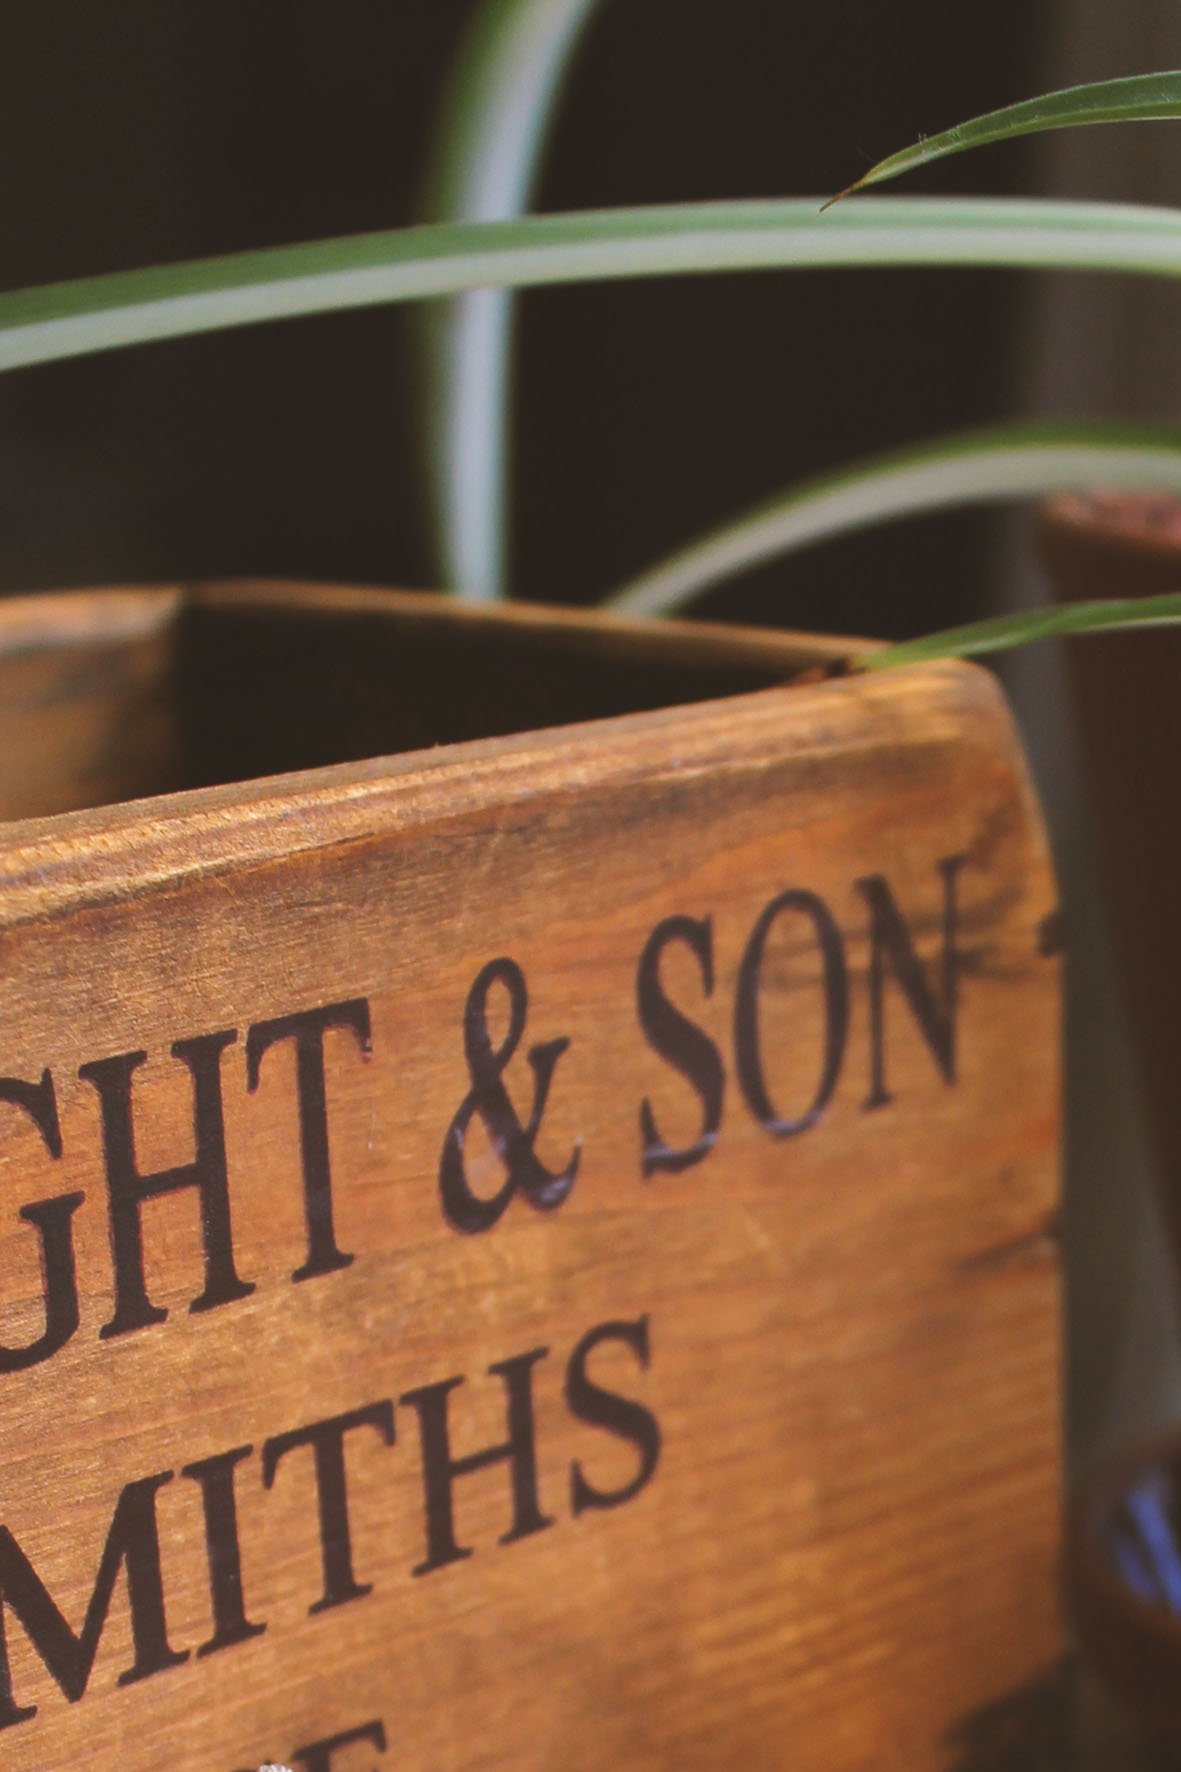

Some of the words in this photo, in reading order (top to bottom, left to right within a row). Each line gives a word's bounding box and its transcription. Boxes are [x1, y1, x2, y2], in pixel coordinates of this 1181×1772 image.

[439, 957, 582, 1236] &
[636, 853, 970, 1181] SON
[0, 1312, 663, 1730] MITHS
